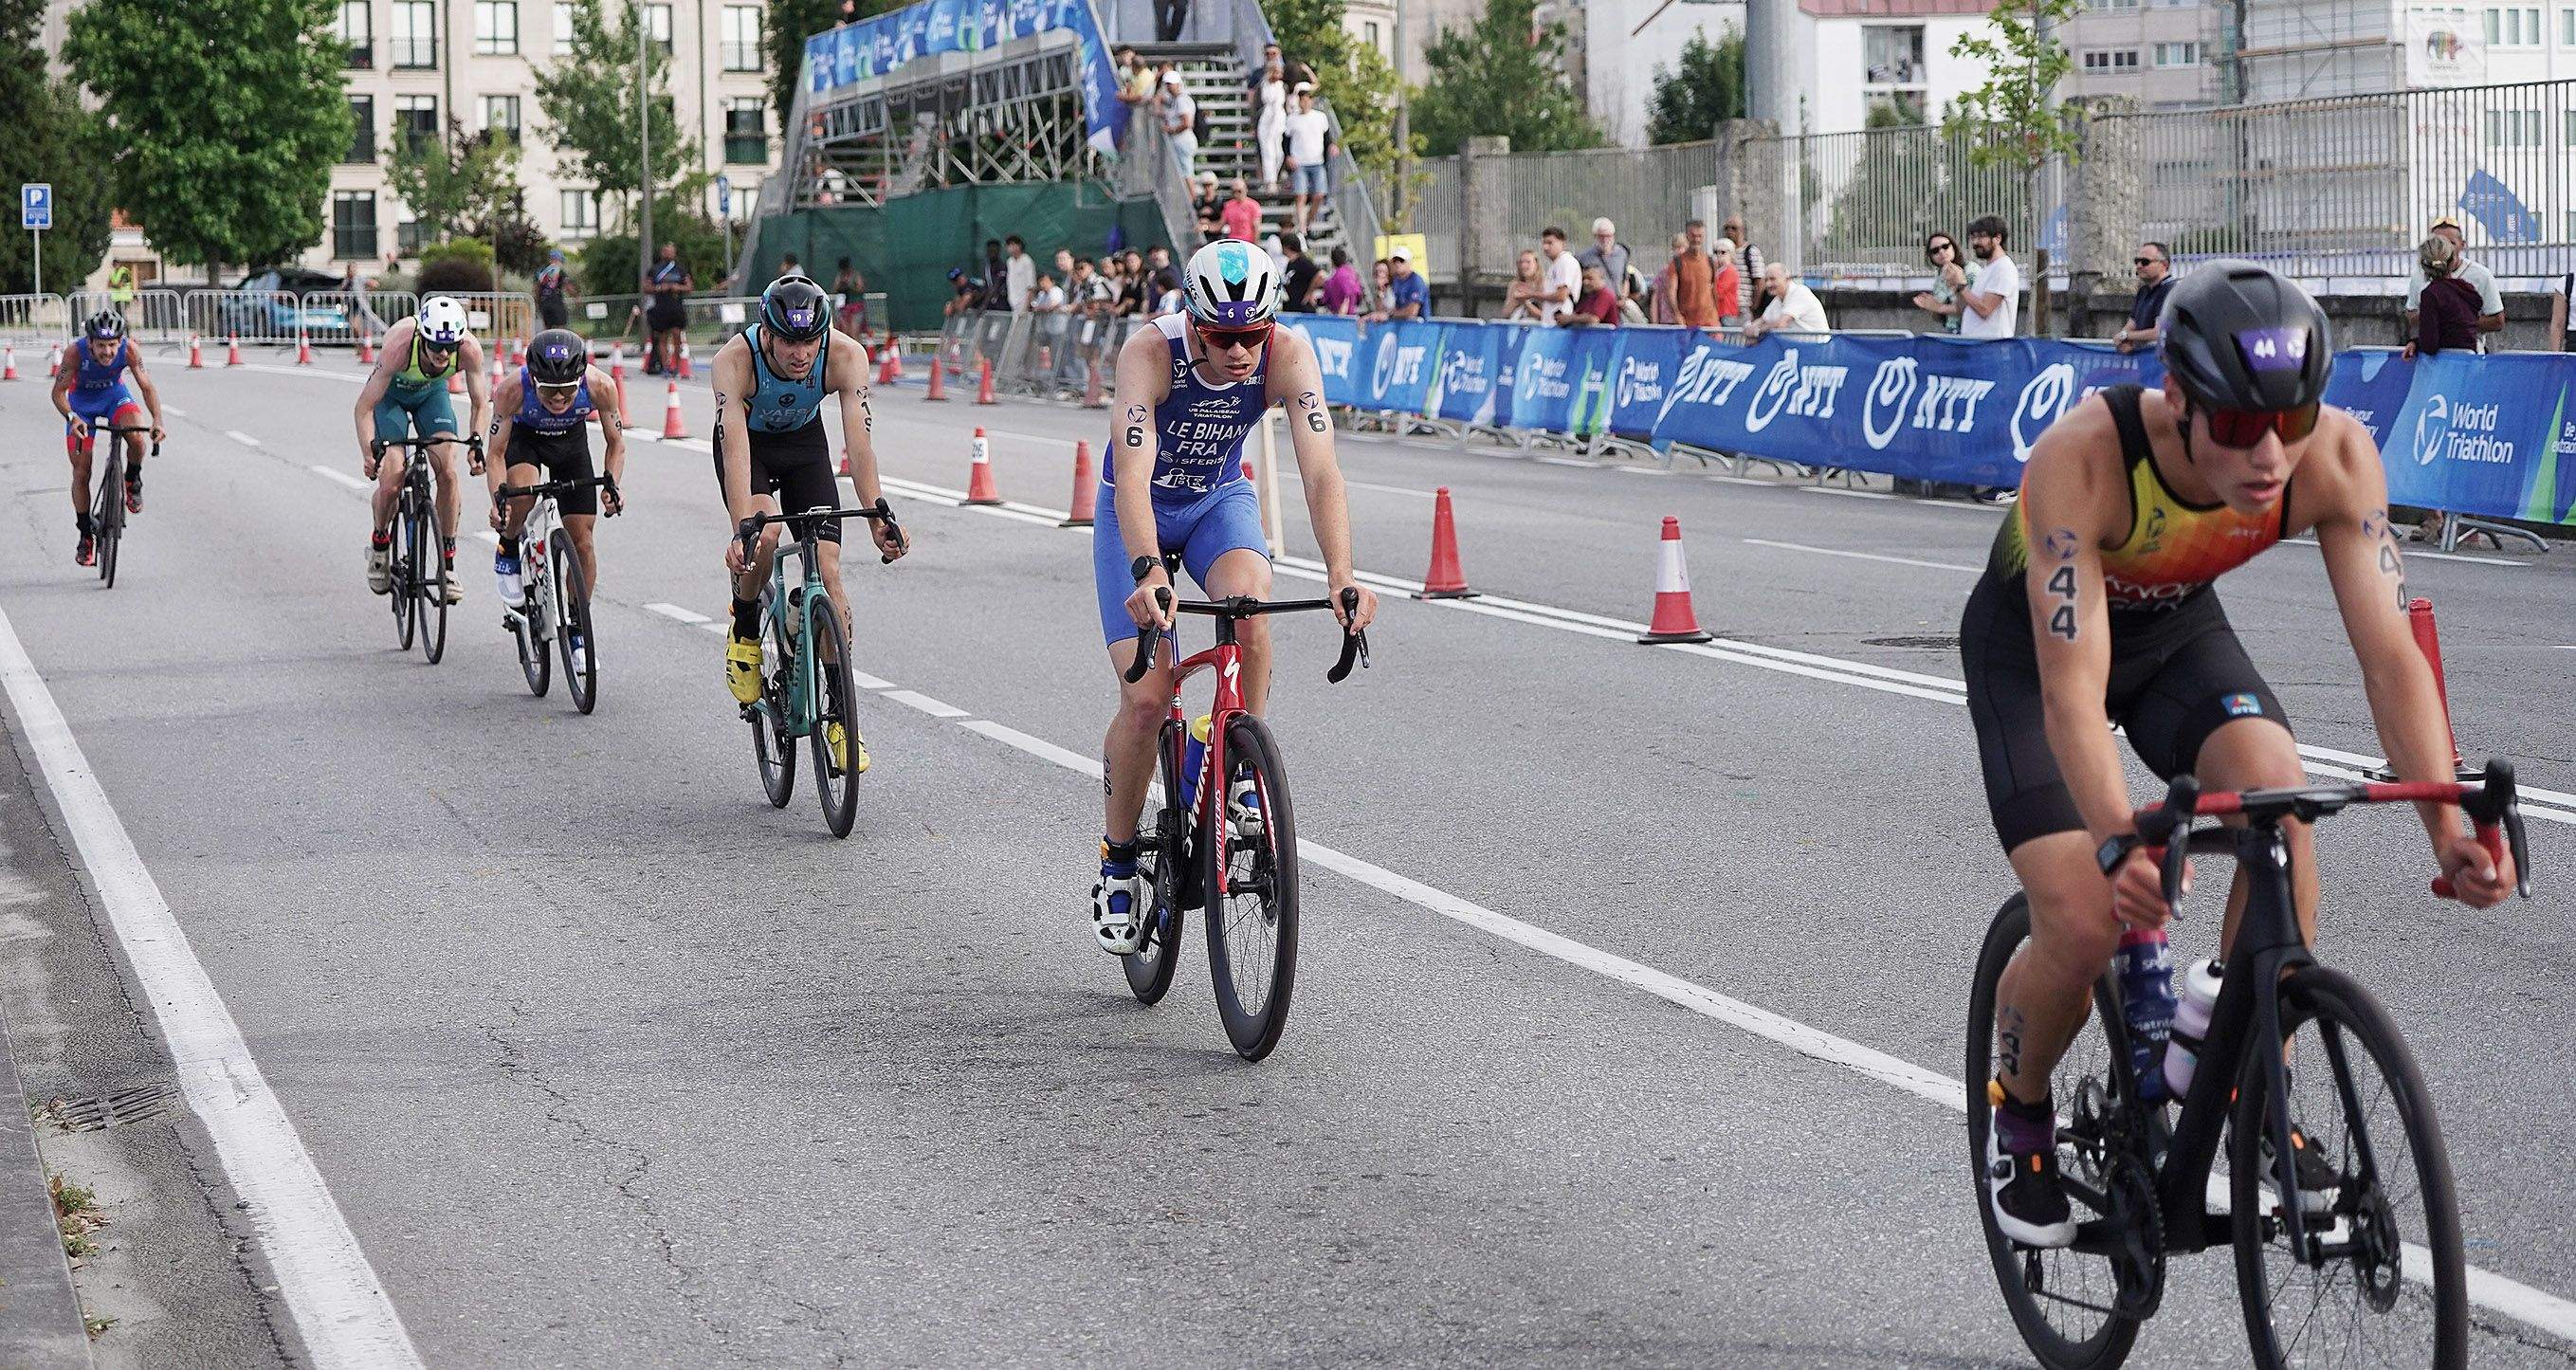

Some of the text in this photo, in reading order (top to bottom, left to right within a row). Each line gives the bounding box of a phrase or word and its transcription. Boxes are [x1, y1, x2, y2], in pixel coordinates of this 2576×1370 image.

[792, 313, 802, 322] 19
[1227, 307, 1234, 319] 6
[2254, 338, 2276, 358] 44
[1786, 366, 1849, 419] NTT
[1912, 374, 1996, 432] NTT
[1308, 411, 1326, 433] 6
[2451, 401, 2499, 431] World
[1126, 427, 1143, 448] 6
[1166, 420, 1249, 441] LE BIHAN
[1176, 440, 1218, 456] FRA
[2446, 430, 2514, 465] Triathlon
[1180, 456, 1225, 466] SFERIS
[2047, 566, 2078, 641] 44
